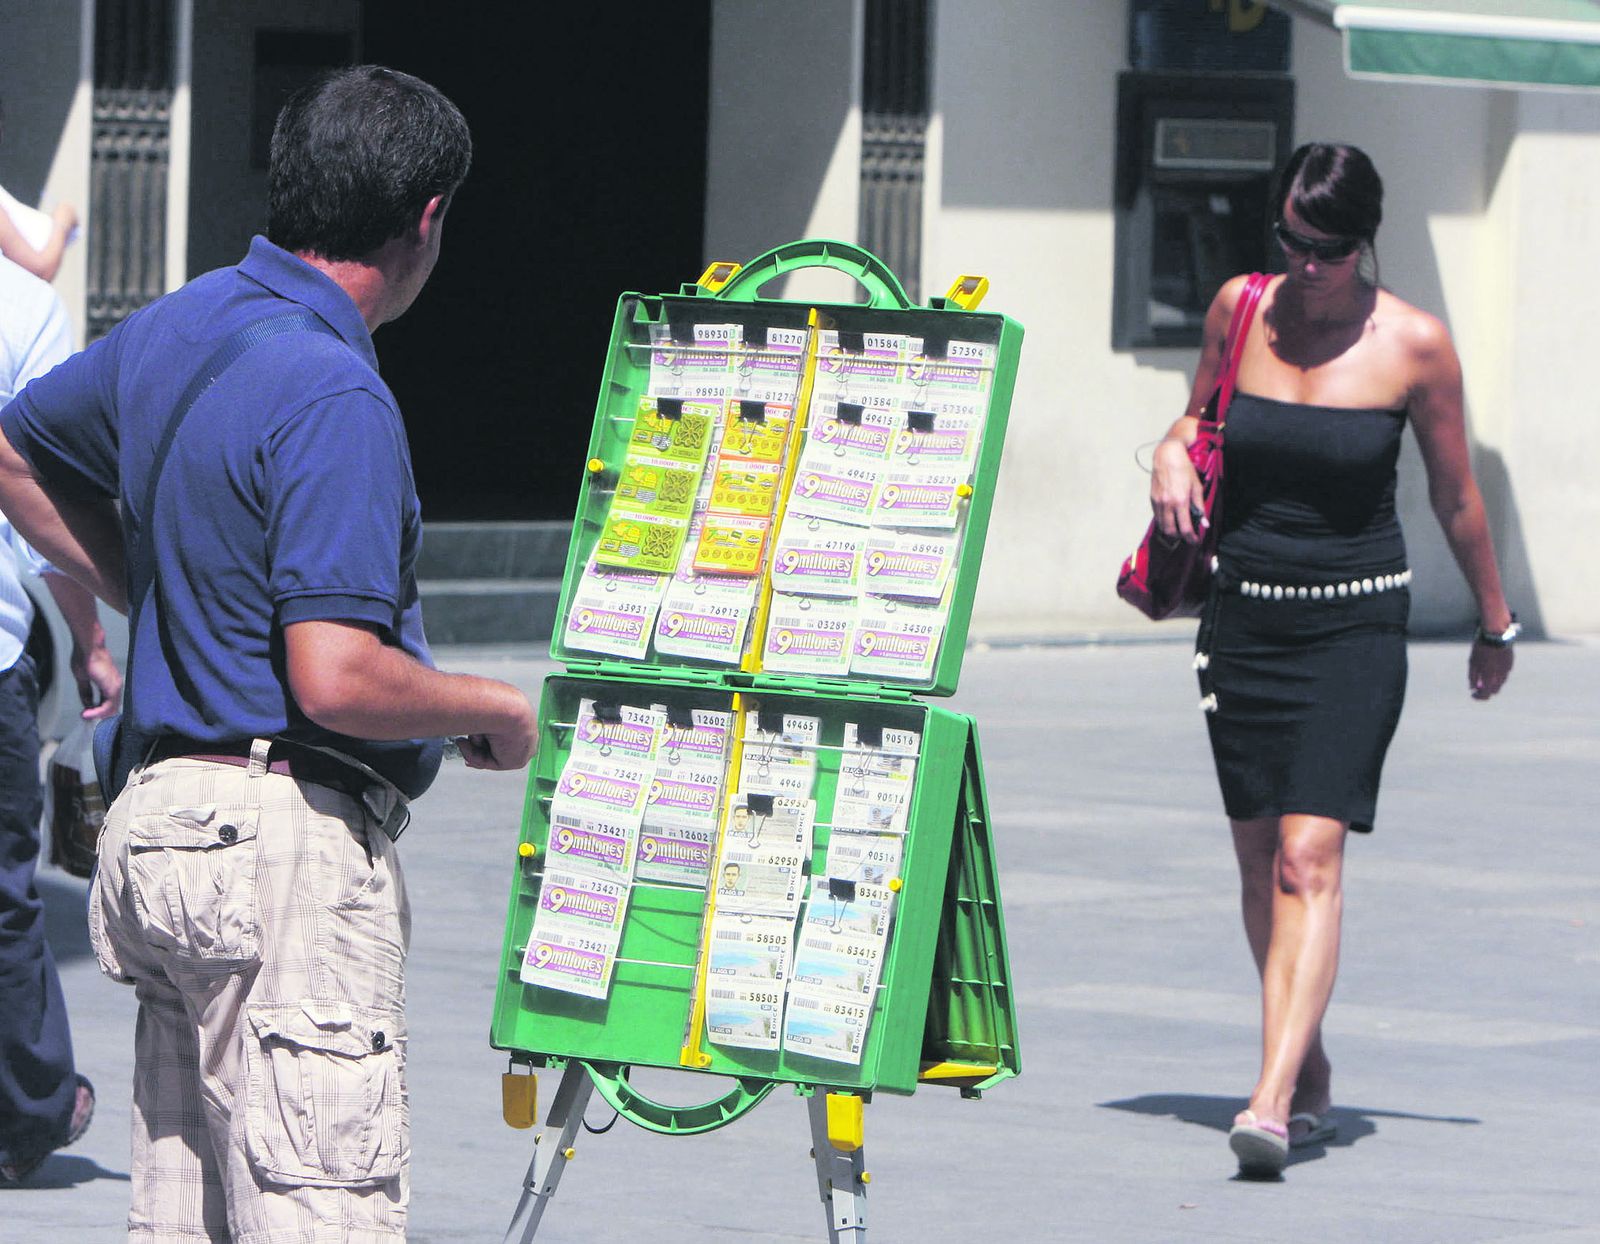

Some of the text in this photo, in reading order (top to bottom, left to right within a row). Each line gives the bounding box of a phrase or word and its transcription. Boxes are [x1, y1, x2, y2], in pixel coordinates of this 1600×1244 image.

[698, 328, 729, 340] 98930
[771, 333, 803, 345] 81270
[867, 337, 898, 349] 01584
[951, 345, 984, 358] 57394
[696, 387, 725, 398] 98930
[861, 395, 892, 407] 01584
[942, 403, 974, 415] 57394
[865, 412, 893, 425] 49415
[847, 468, 876, 481] 49415
[825, 540, 856, 551] 47196
[912, 543, 944, 555] 68948
[618, 603, 647, 614] 63931
[709, 605, 739, 618] 76912
[817, 619, 847, 631] 03289
[902, 622, 932, 634] 34309
[627, 711, 655, 726] 73421
[697, 714, 725, 727] 12602
[786, 719, 814, 731] 49465
[886, 733, 913, 746] 90516
[614, 768, 643, 782] 73421
[689, 772, 718, 785] 12602
[877, 792, 904, 805] 90516
[597, 822, 626, 837] 73421
[679, 829, 708, 842] 12602
[768, 855, 798, 867] 62950
[868, 850, 895, 863] 90516
[789, 869, 797, 891] ONCE
[591, 881, 619, 896] 73421
[859, 887, 889, 901] 83415
[879, 905, 888, 927] ONCE
[756, 932, 787, 945] 58503
[578, 939, 607, 953] 73421
[846, 945, 877, 959] 83415
[749, 991, 779, 1004] 58503
[834, 1004, 865, 1019] 83415
[854, 1021, 863, 1044] ONCE
